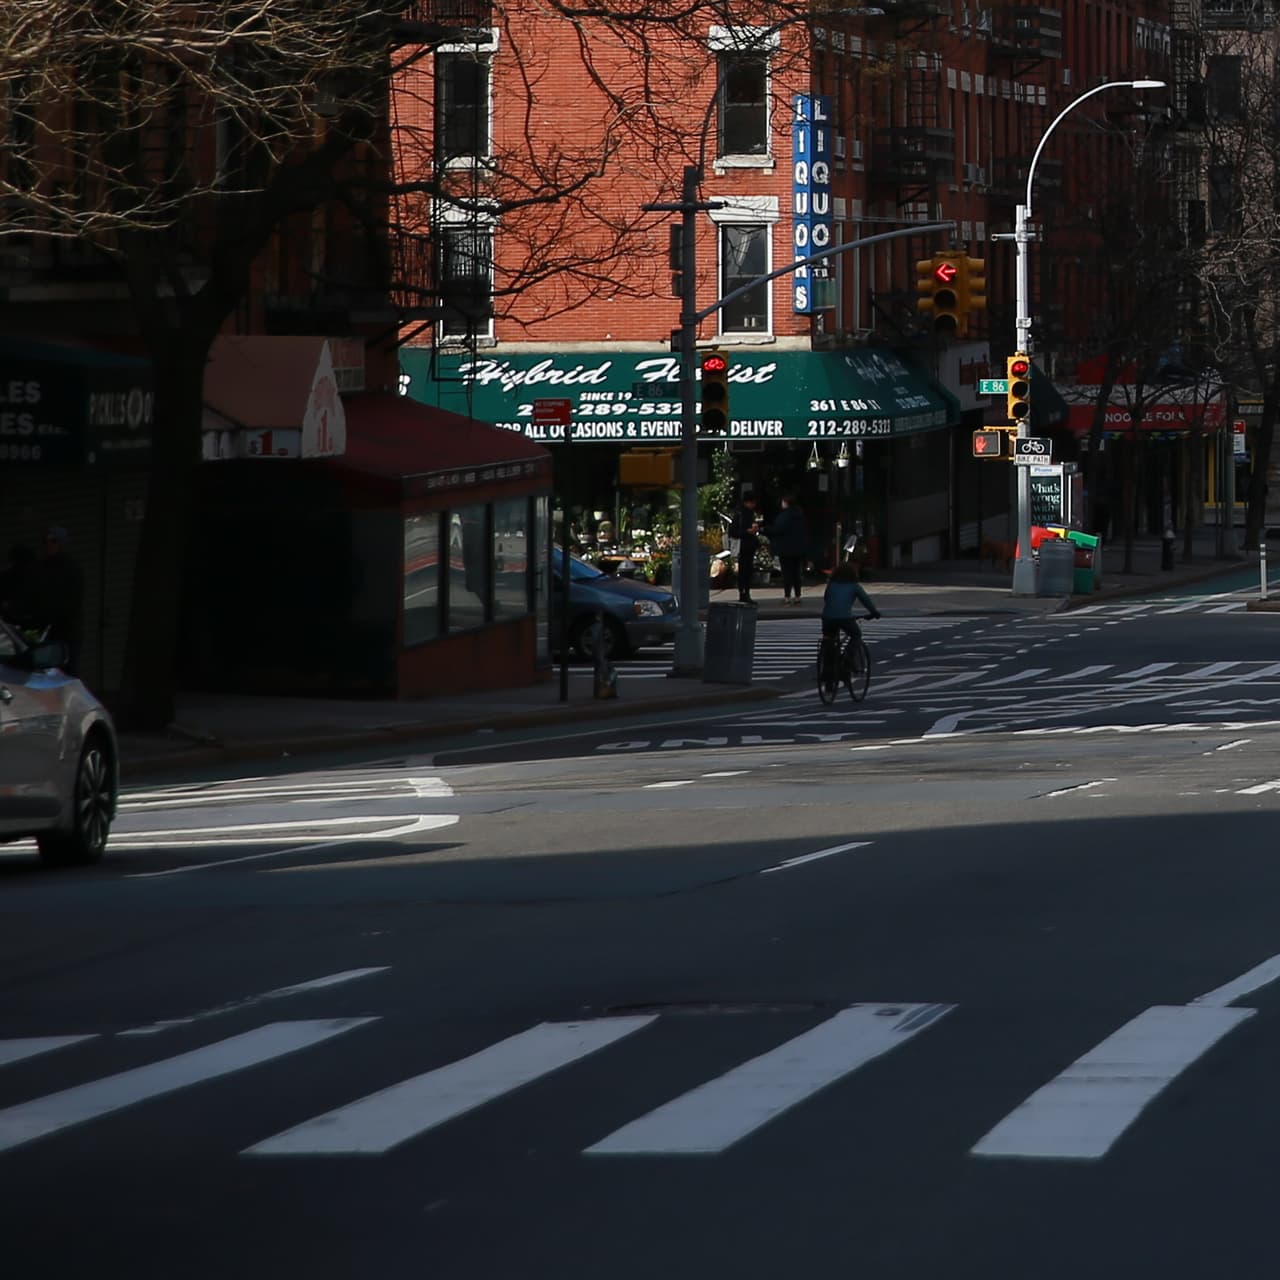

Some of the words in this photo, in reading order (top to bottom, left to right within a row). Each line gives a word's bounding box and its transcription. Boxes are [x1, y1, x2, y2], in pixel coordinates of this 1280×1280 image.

[795, 98, 809, 310] LIQUORS
[458, 358, 612, 393] Hybrid
[634, 357, 777, 385] Flist
[982, 381, 989, 392] E
[992, 381, 1005, 392] 86
[579, 392, 616, 402] SINCE
[617, 391, 644, 402] 19
[809, 399, 837, 412] 361
[840, 399, 851, 411] E
[525, 421, 548, 438] ALL
[627, 421, 638, 437] &
[730, 420, 783, 437] DELIVER
